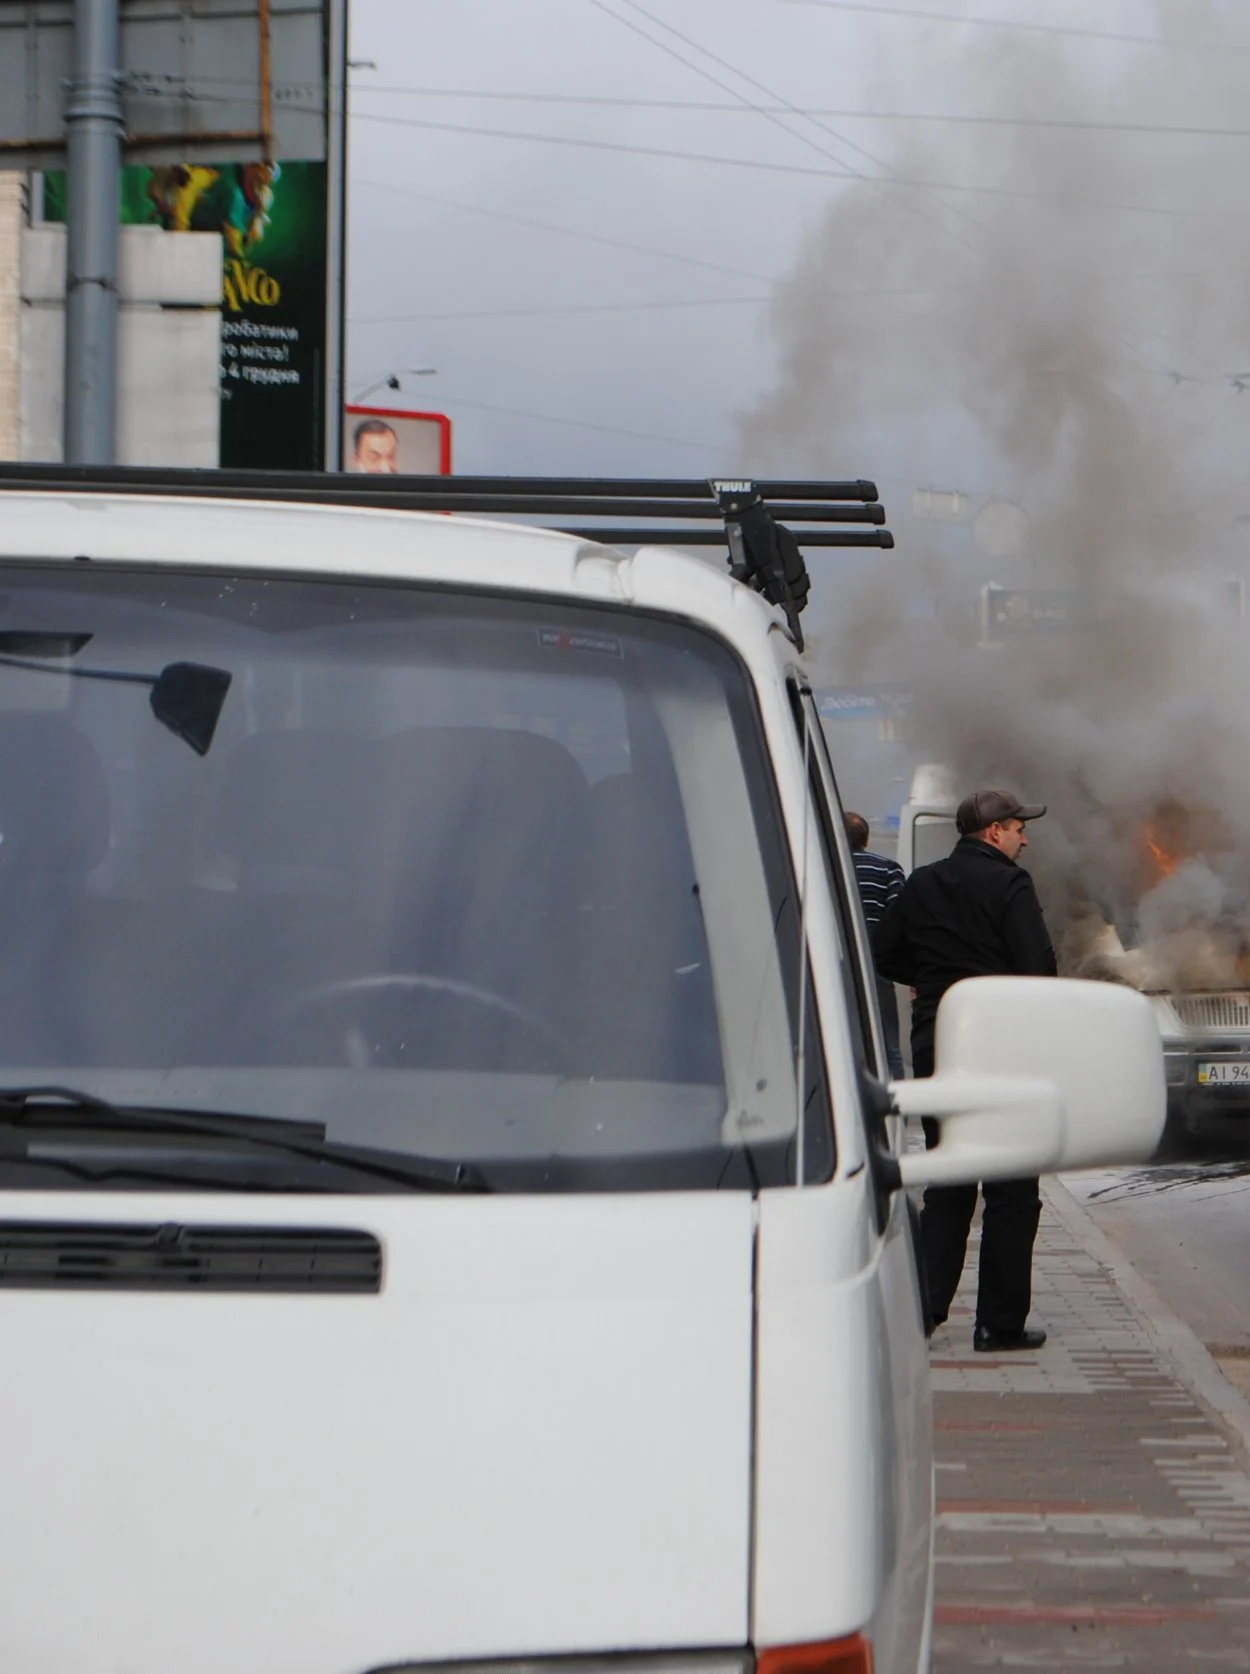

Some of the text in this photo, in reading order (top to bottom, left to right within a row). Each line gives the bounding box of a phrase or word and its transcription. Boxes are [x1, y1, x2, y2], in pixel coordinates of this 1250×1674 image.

[221, 320, 299, 341] робатики
[240, 342, 289, 361] міста!
[228, 361, 240, 379] 4
[242, 365, 300, 385] грудня
[714, 481, 751, 492] THULE
[1209, 1066, 1226, 1080] AI
